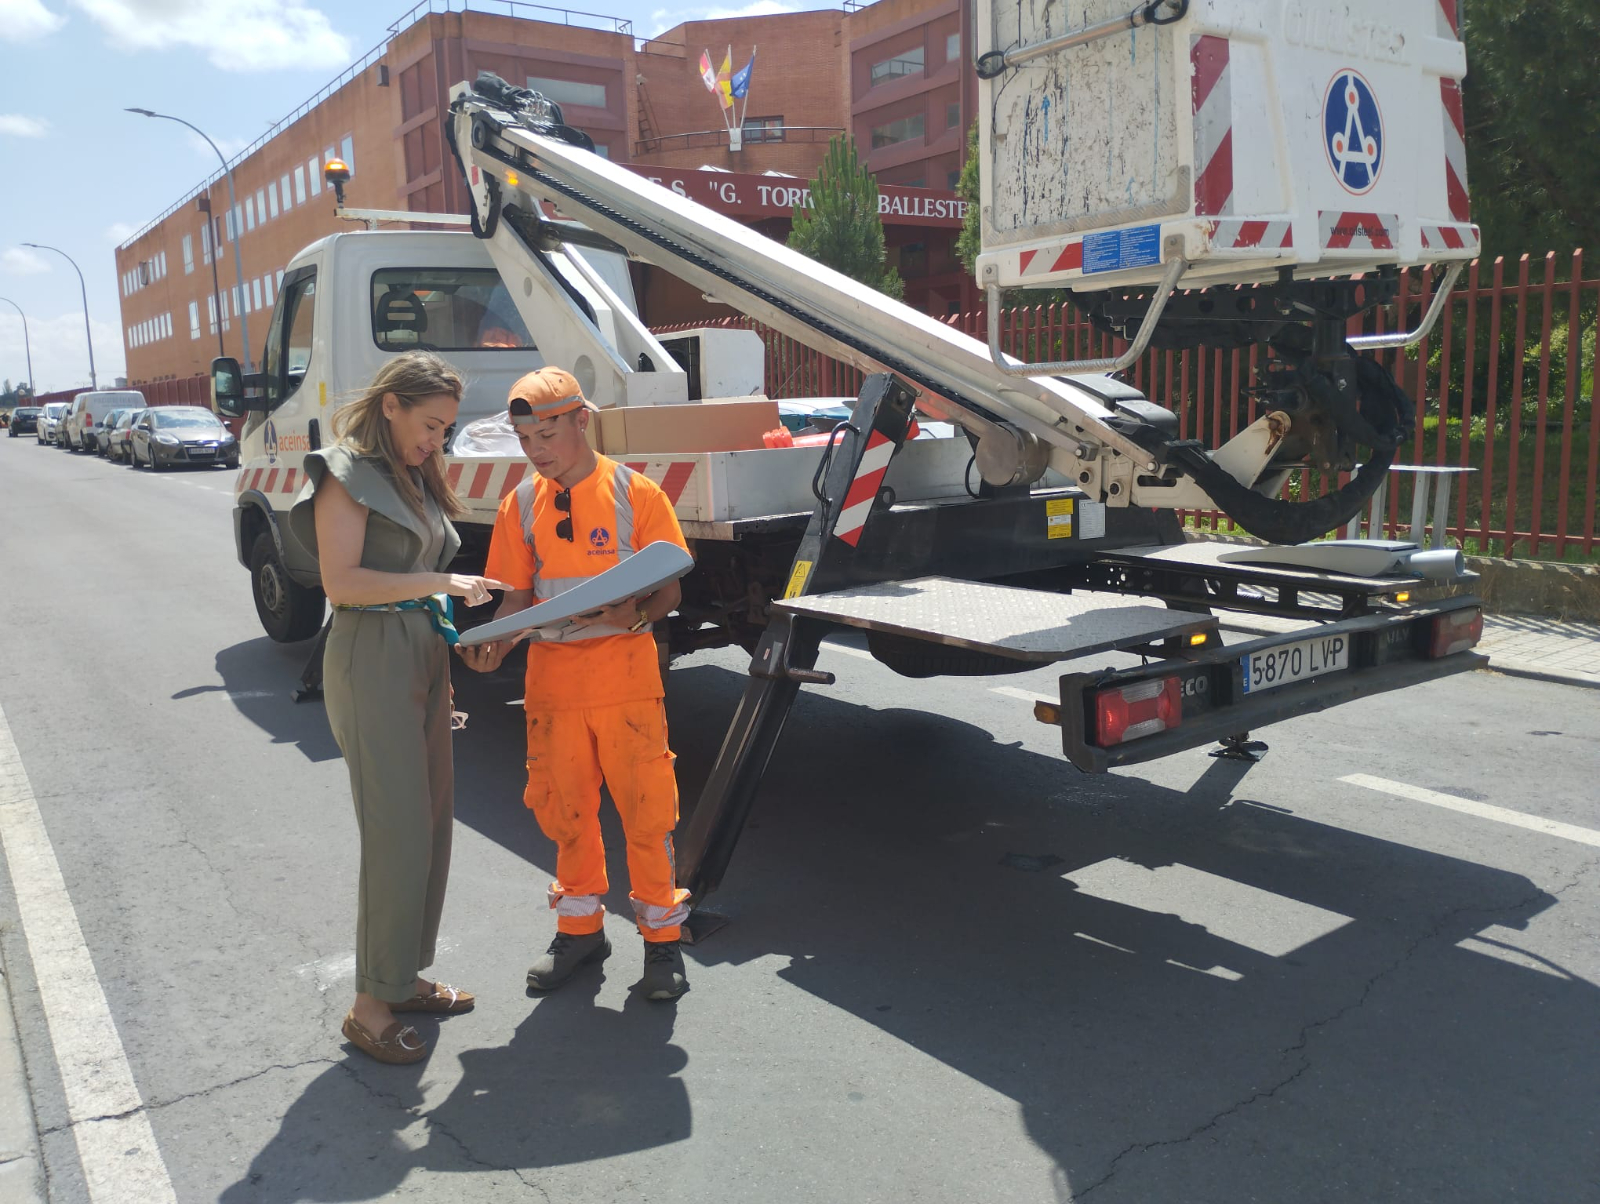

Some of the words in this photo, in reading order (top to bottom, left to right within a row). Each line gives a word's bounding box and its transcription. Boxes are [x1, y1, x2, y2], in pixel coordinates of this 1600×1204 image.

[709, 181, 742, 204] "G.
[757, 185, 816, 210] TORR
[877, 194, 975, 219] BALLESTE
[587, 548, 615, 556] aceinsa
[1252, 646, 1302, 686] 5870
[1310, 637, 1344, 672] LVP
